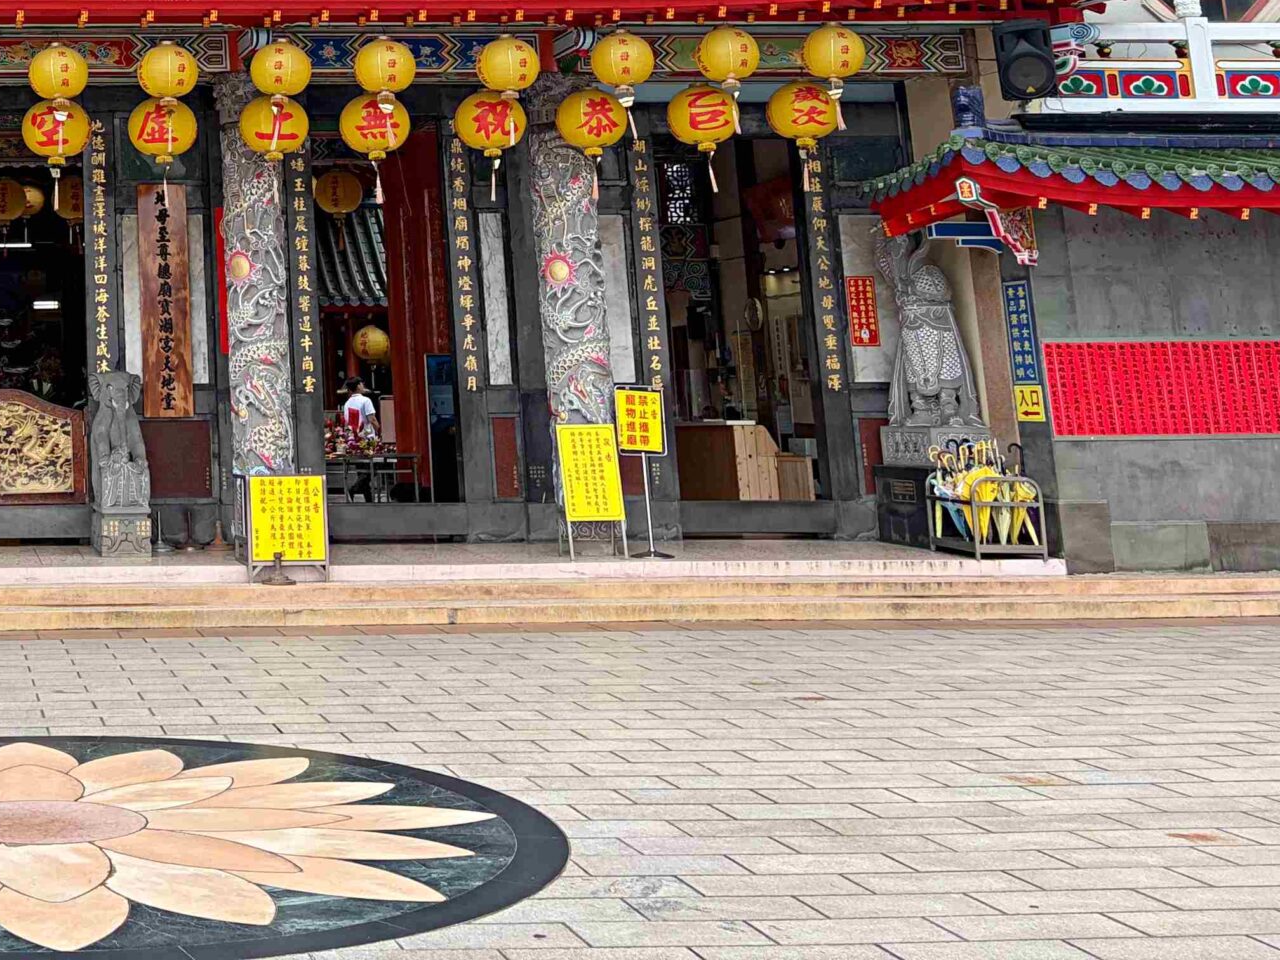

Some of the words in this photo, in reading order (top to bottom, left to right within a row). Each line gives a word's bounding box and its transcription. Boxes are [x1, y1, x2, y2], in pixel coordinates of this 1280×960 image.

[31, 106, 68, 147] 空
[255, 107, 299, 140] 上
[356, 101, 400, 139] 無
[473, 100, 518, 140] 祝
[578, 97, 619, 137] 恭
[792, 89, 829, 126] 歲次
[1019, 390, 1040, 407] 入口
[638, 395, 650, 446] 禁止攜帶
[311, 486, 321, 514] 公告
